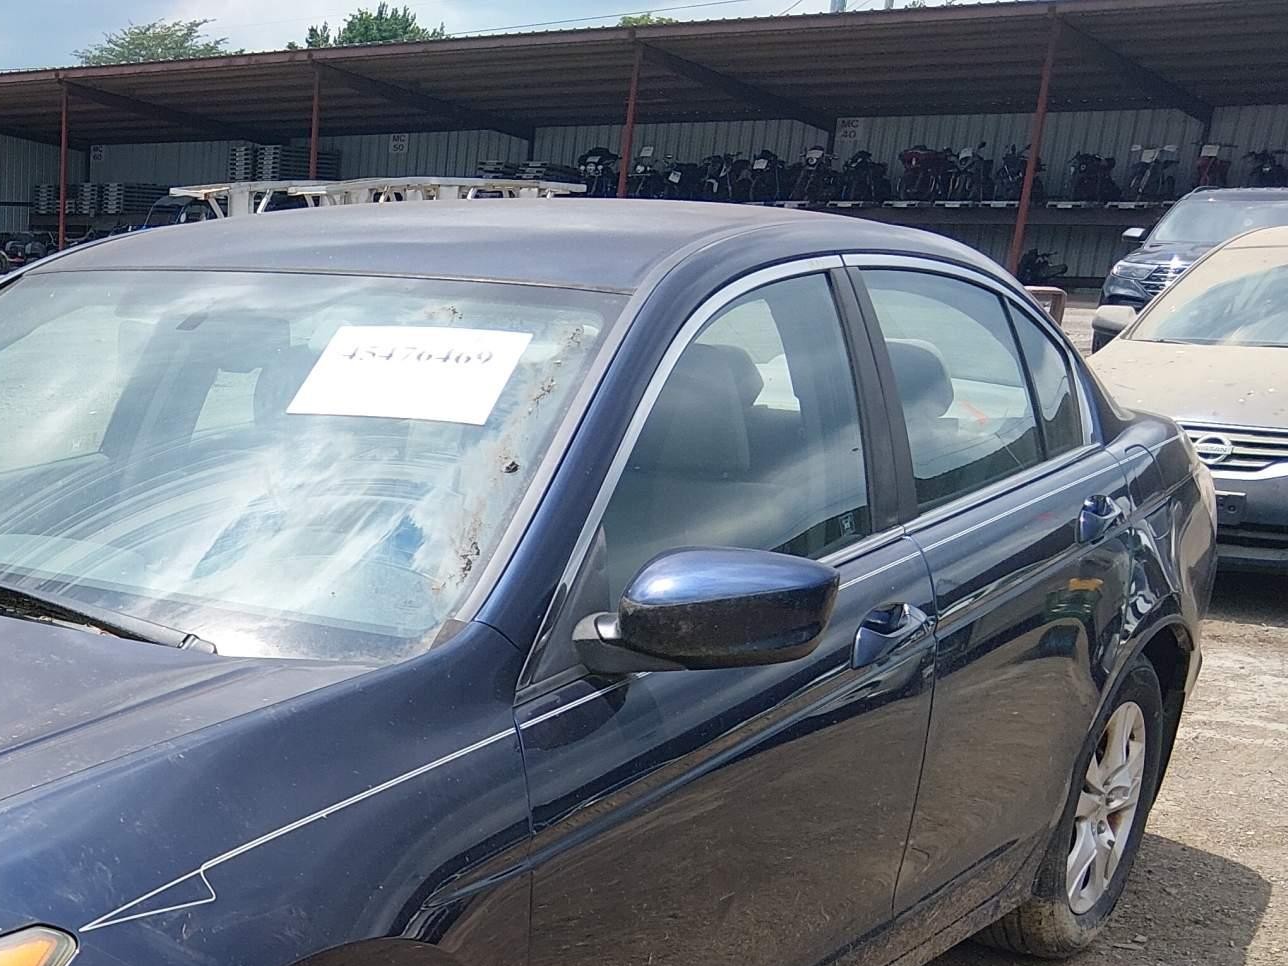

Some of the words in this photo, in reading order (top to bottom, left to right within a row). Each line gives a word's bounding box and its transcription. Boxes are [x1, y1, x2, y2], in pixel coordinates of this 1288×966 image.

[840, 119, 859, 128] MC
[392, 134, 406, 143] MC
[841, 129, 857, 139] 40
[392, 143, 405, 152] 50
